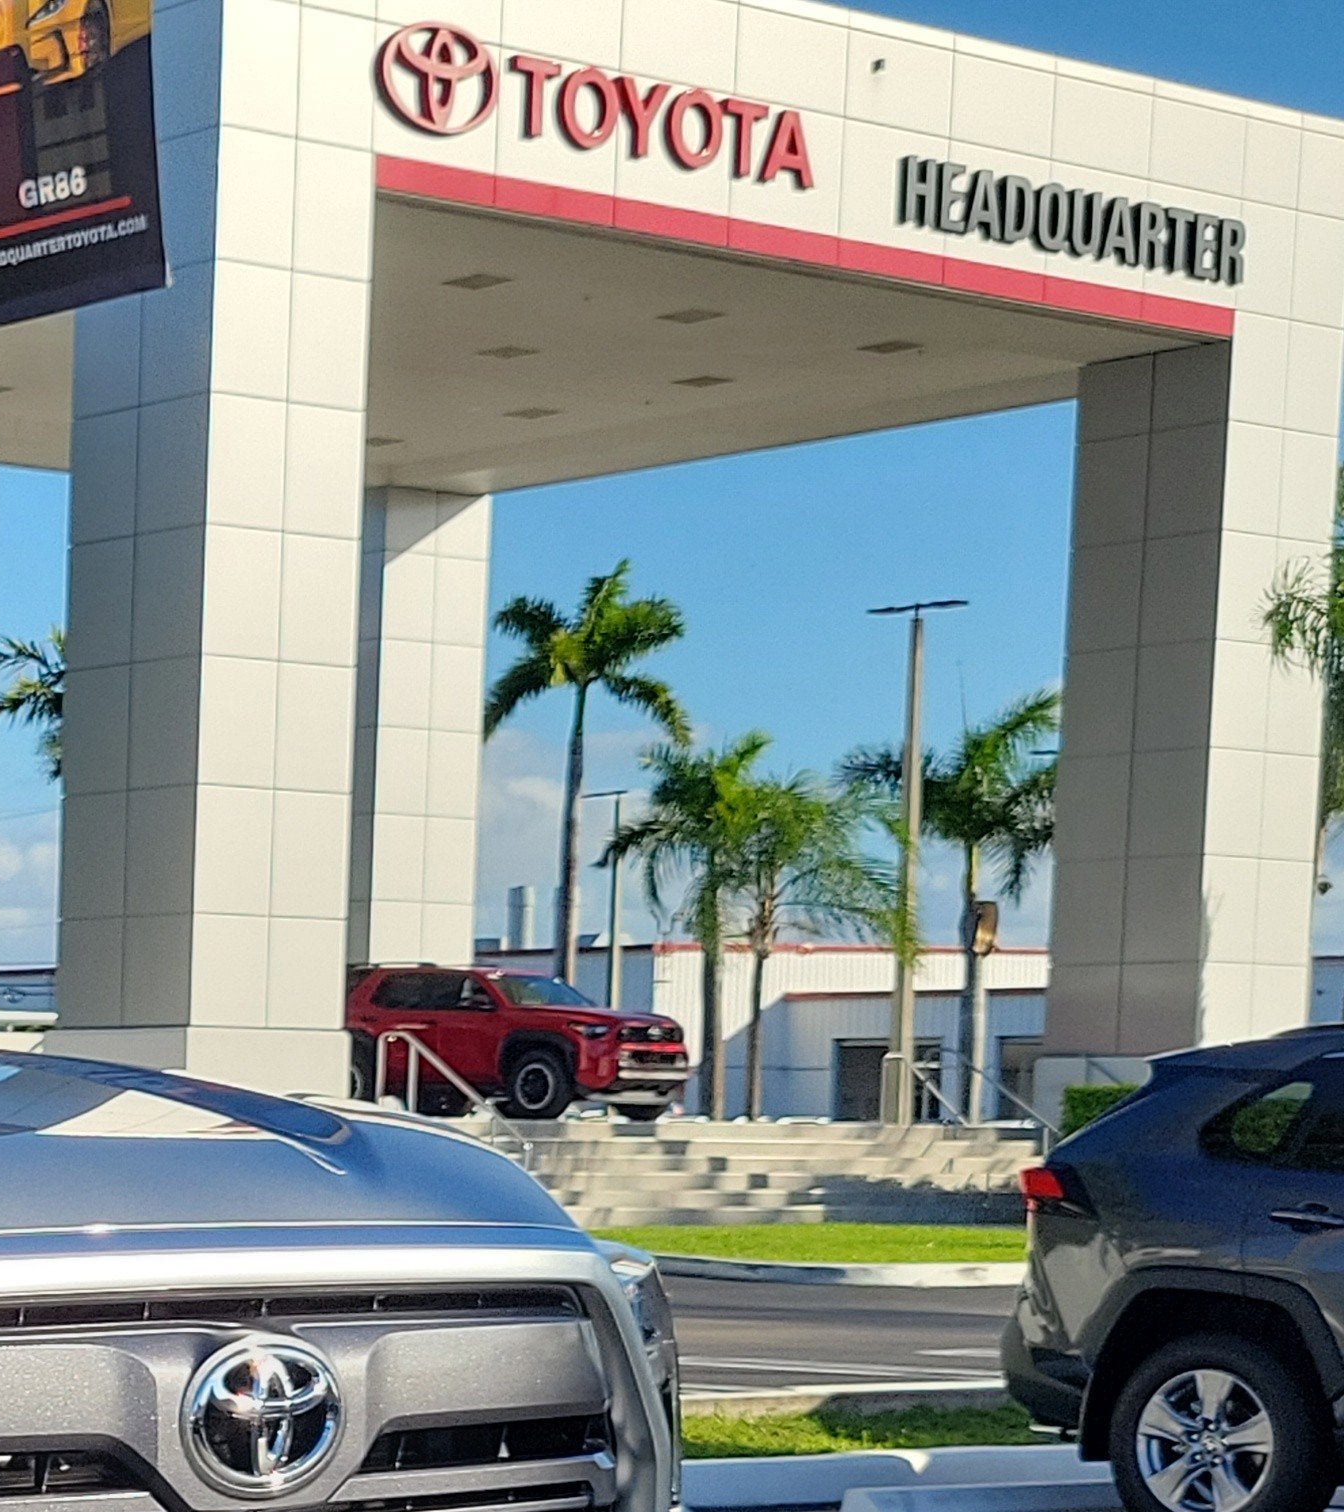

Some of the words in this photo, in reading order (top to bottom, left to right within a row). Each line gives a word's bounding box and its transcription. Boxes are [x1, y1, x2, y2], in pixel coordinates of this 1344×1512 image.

[18, 166, 88, 209] GR86
[510, 55, 815, 190] TOYOTA
[897, 155, 1247, 286] HEADQUARTER
